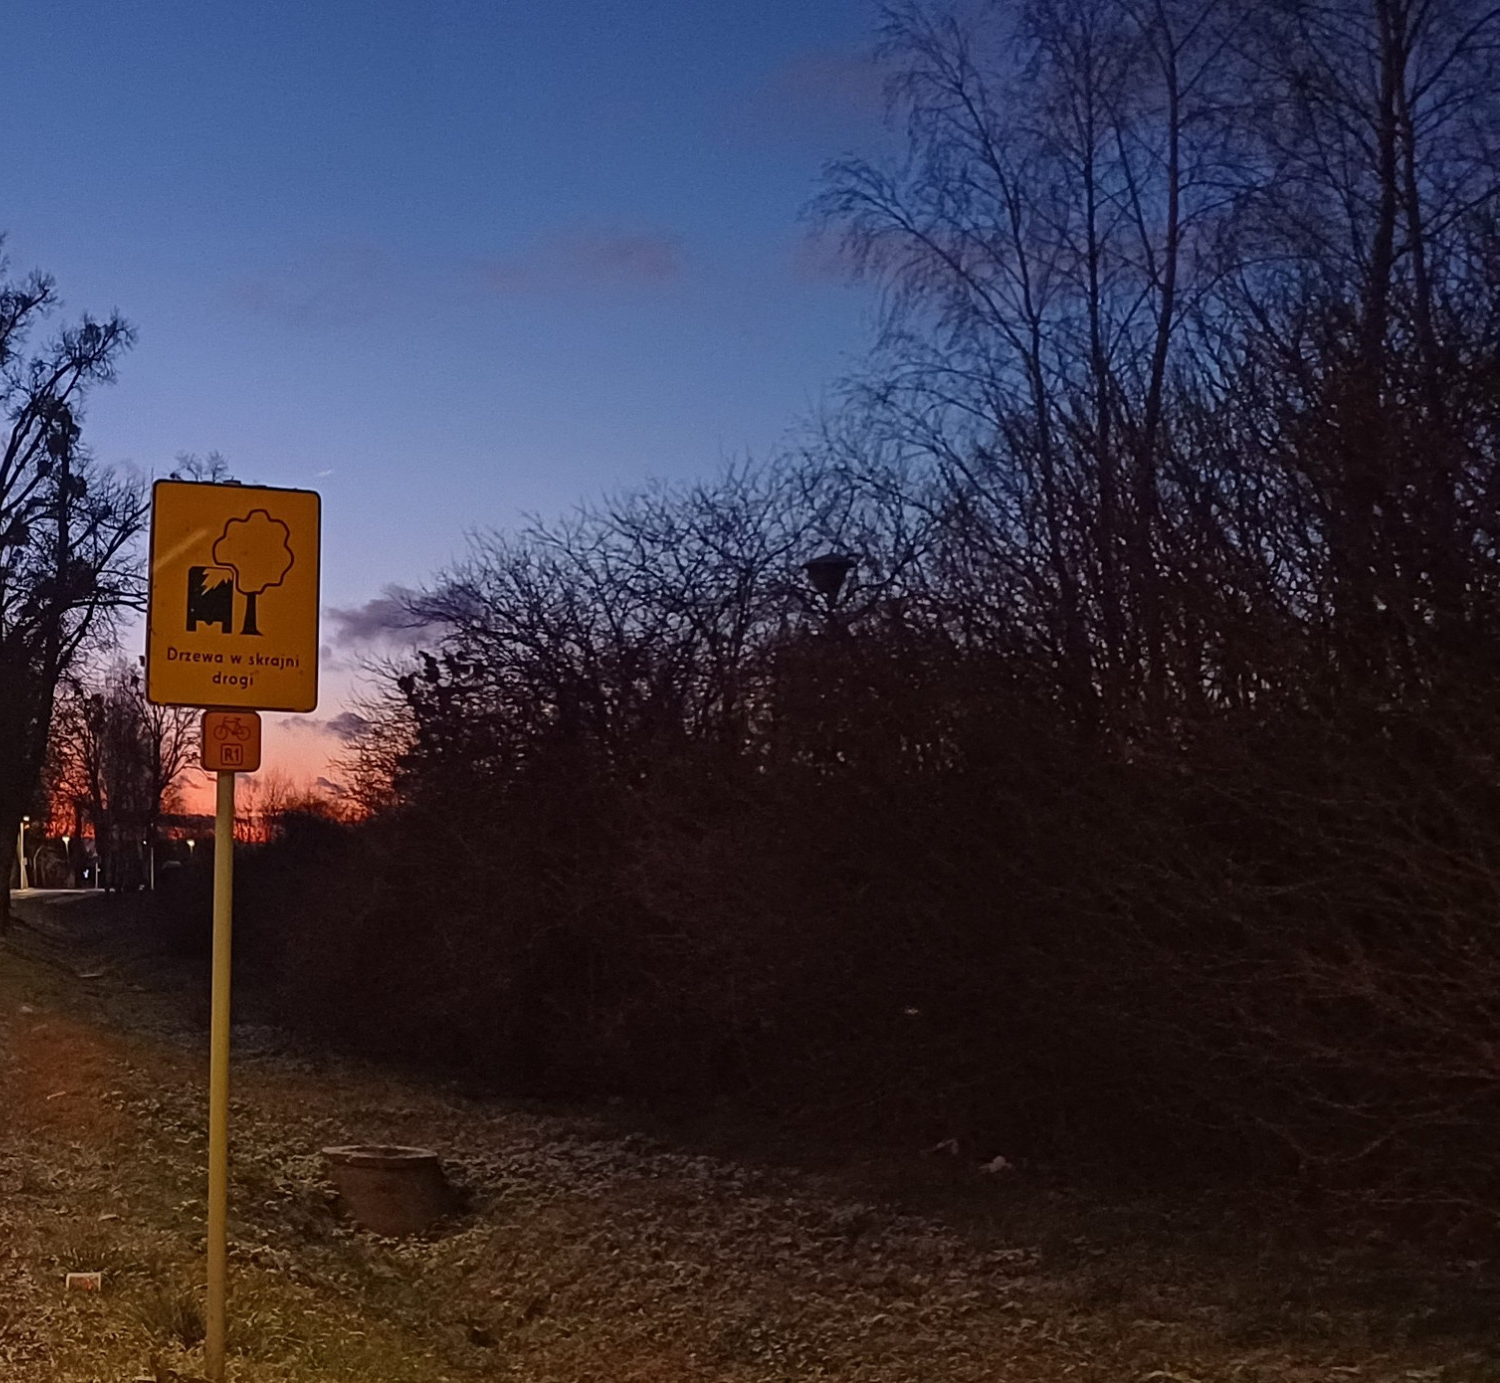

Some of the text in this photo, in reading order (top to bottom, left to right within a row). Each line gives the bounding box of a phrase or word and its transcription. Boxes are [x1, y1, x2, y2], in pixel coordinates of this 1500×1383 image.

[167, 647, 299, 669] Drzewa w skrajni
[212, 672, 254, 689] drogi
[224, 748, 239, 761] R1
